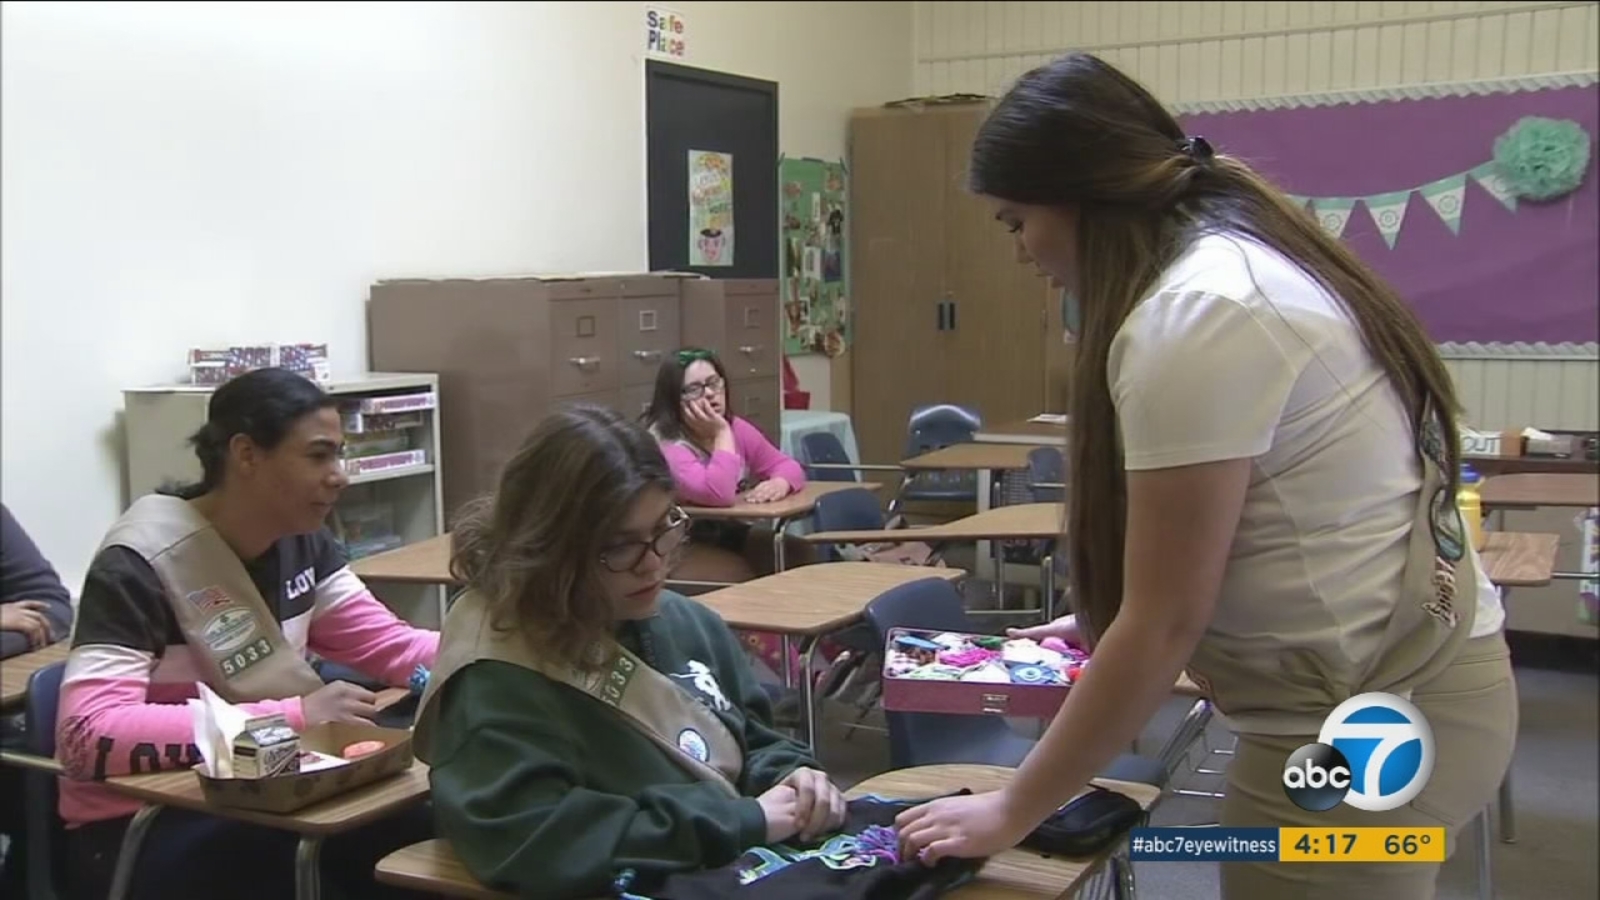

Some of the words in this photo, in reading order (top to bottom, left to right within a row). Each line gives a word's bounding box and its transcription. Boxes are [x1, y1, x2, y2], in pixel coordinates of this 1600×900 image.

[647, 10, 684, 34] Safe
[648, 29, 685, 57] Place
[222, 639, 271, 675] 5033
